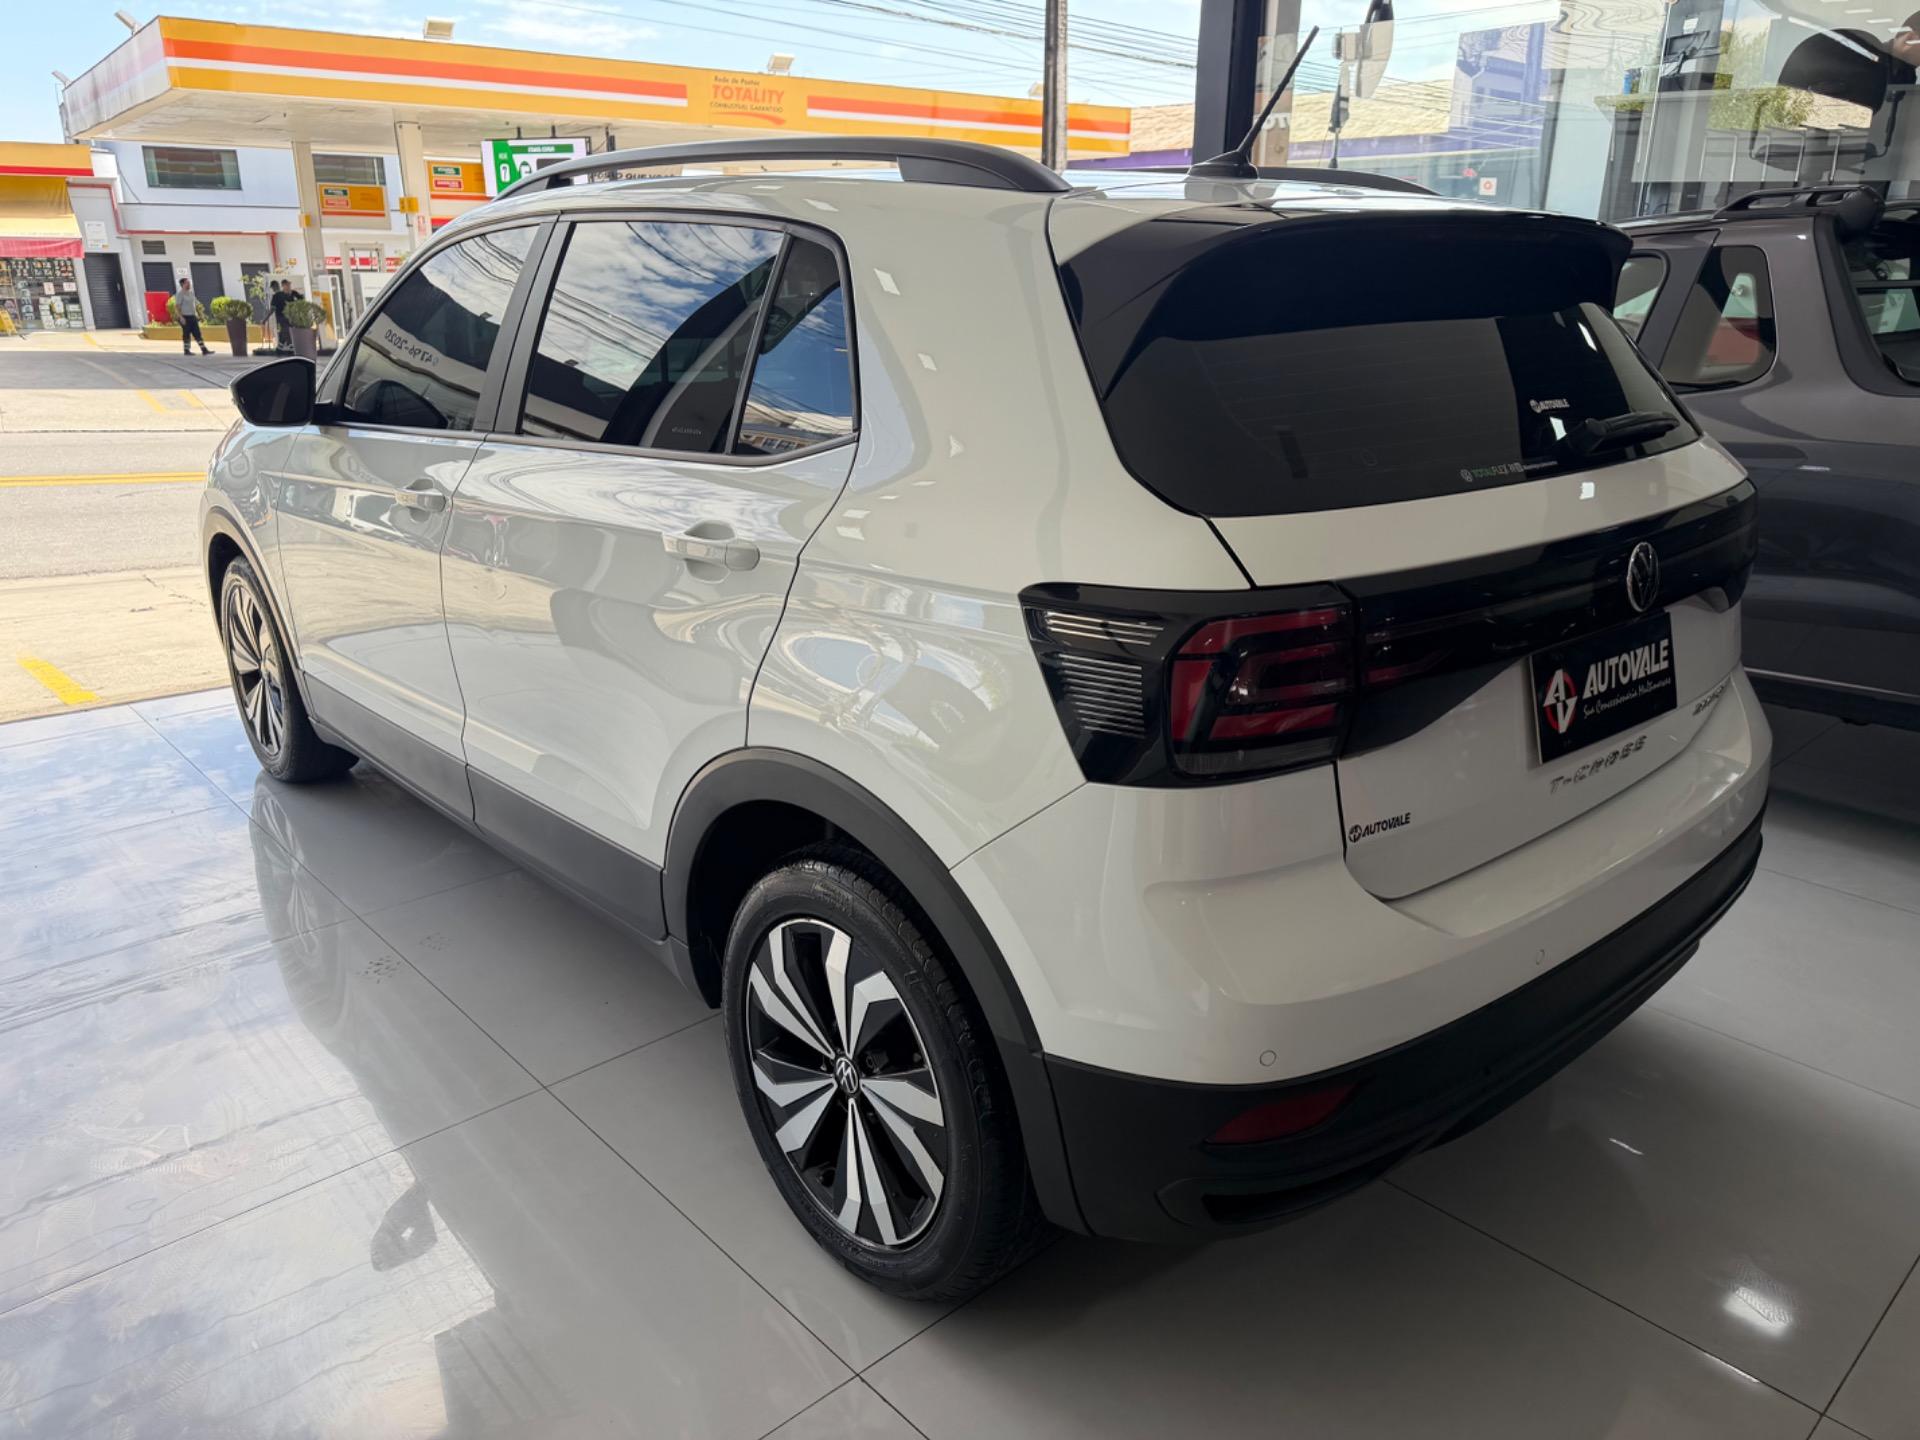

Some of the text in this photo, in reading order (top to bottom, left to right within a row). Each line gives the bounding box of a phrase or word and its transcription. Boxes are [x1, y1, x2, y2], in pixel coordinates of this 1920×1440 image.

[712, 84, 785, 104] TOTALITY
[1582, 638, 1669, 700] AUTOVALE
[1551, 735, 1648, 792] T-CROSS
[1362, 812, 1411, 838] AUTOVALE
